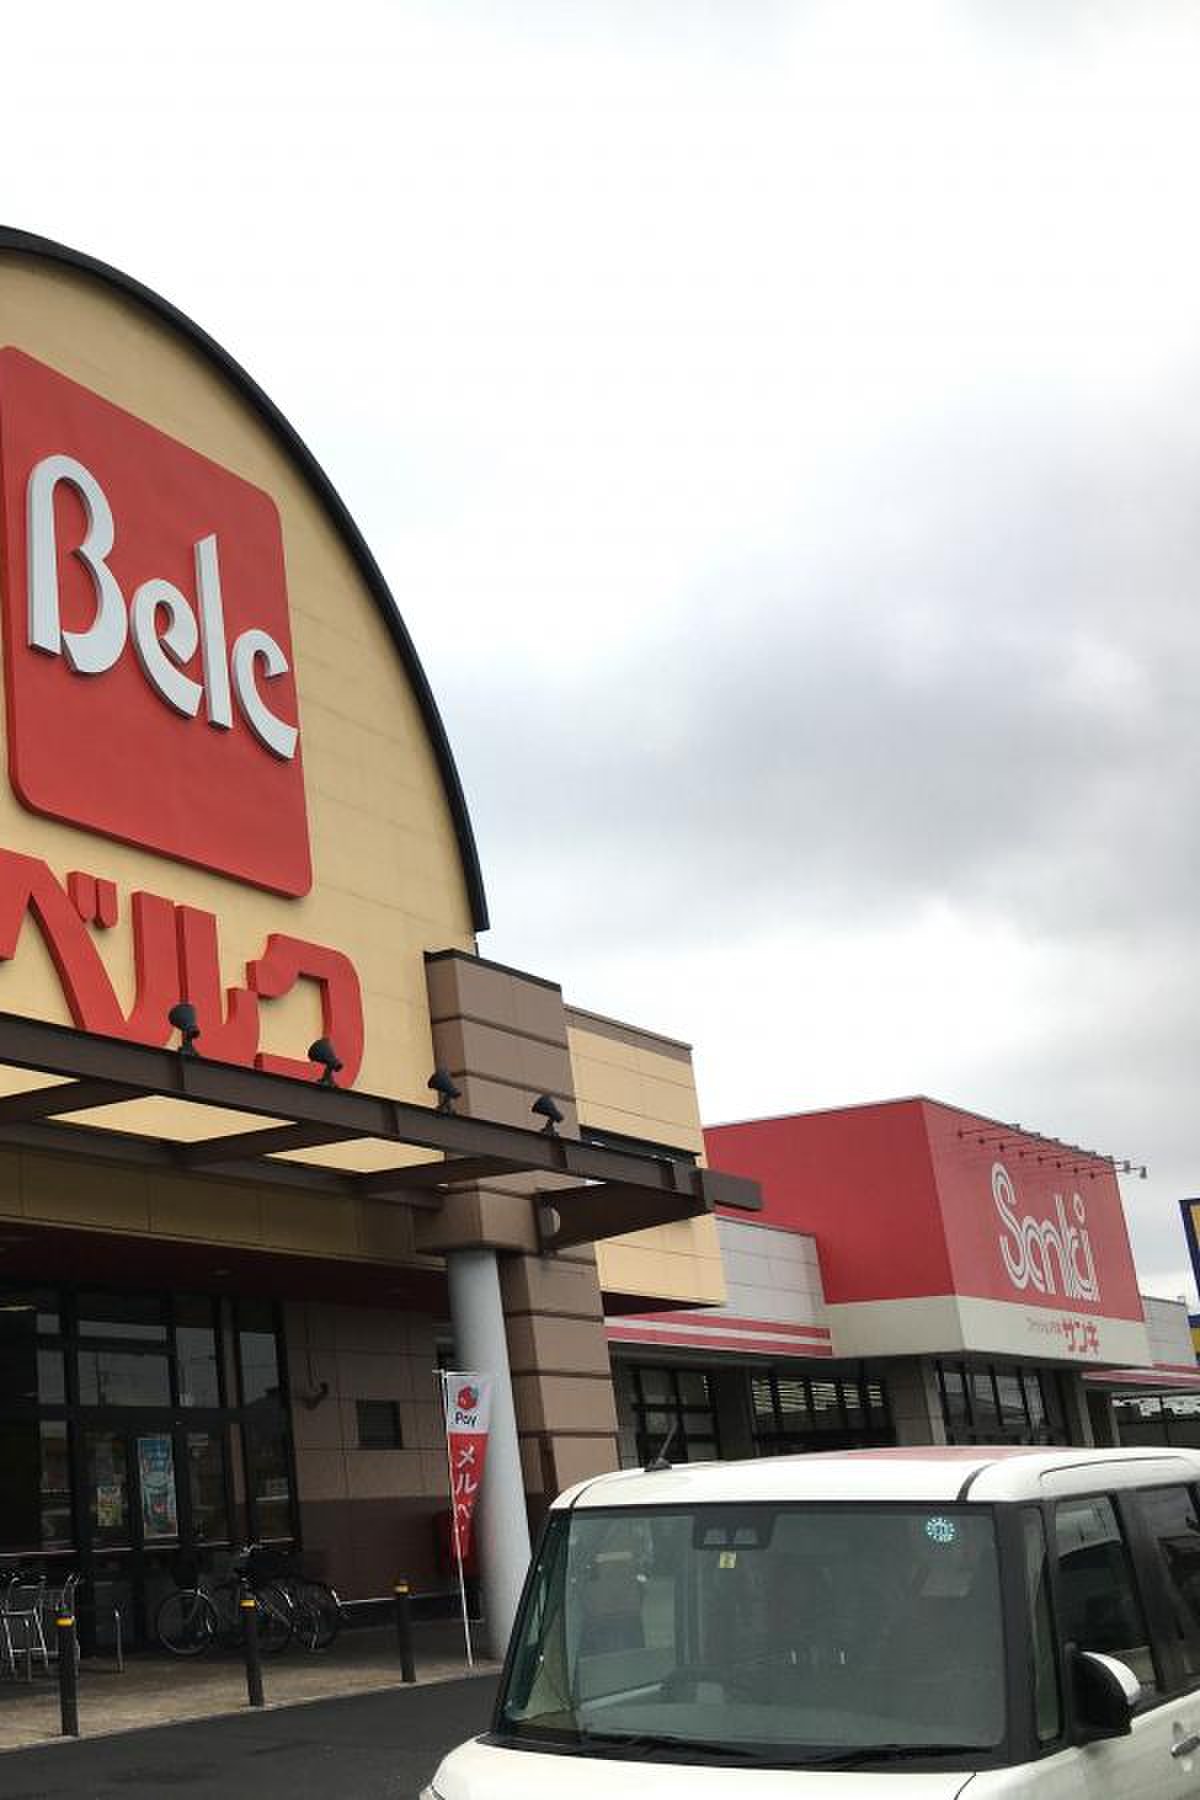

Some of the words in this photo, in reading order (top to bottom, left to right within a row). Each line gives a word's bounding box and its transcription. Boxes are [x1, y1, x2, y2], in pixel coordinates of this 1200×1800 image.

[28, 454, 298, 760] Belc
[455, 1411, 478, 1426] Pay
[456, 1445, 478, 1545] メルペ
